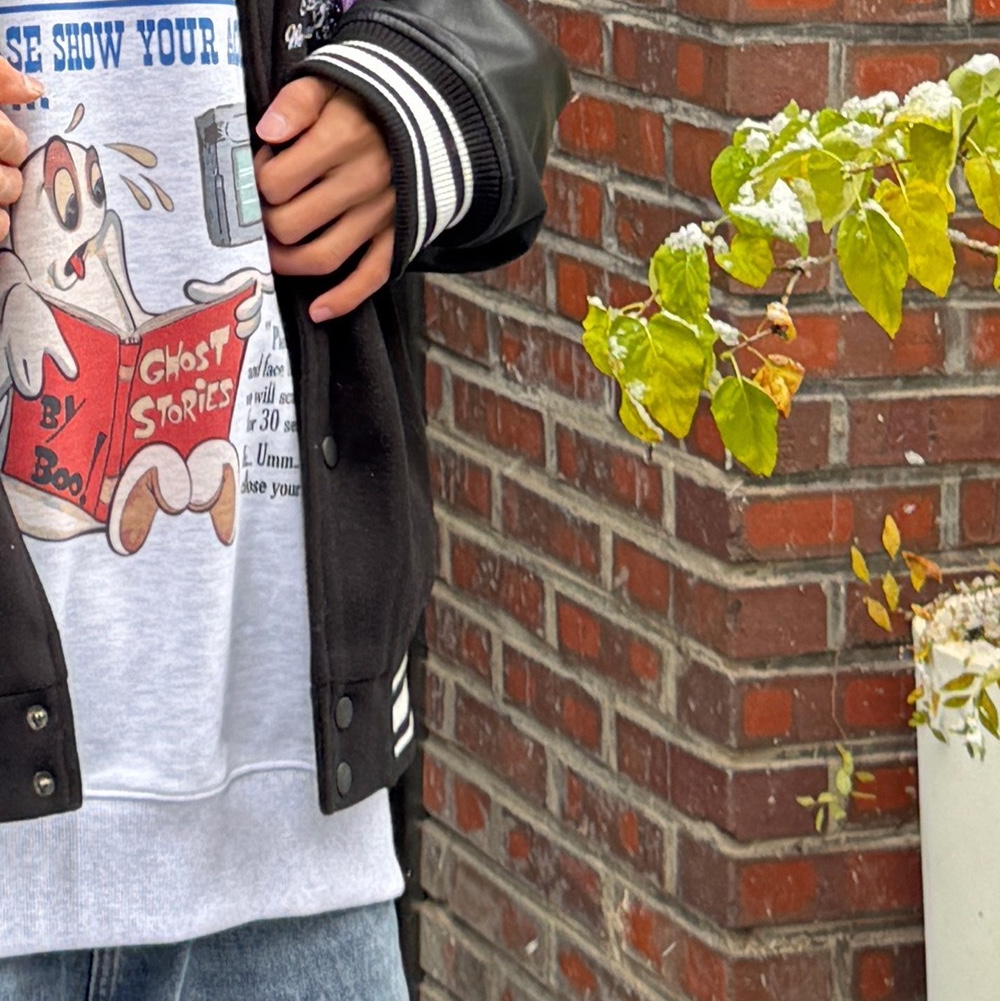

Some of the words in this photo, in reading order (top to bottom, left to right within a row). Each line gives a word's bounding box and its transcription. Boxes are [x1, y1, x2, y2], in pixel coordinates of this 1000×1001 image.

[52, 20, 124, 72] SHOW
[136, 17, 219, 67] YOUR
[139, 324, 231, 386] GHOST
[40, 394, 86, 443] BY
[259, 408, 280, 432] 30
